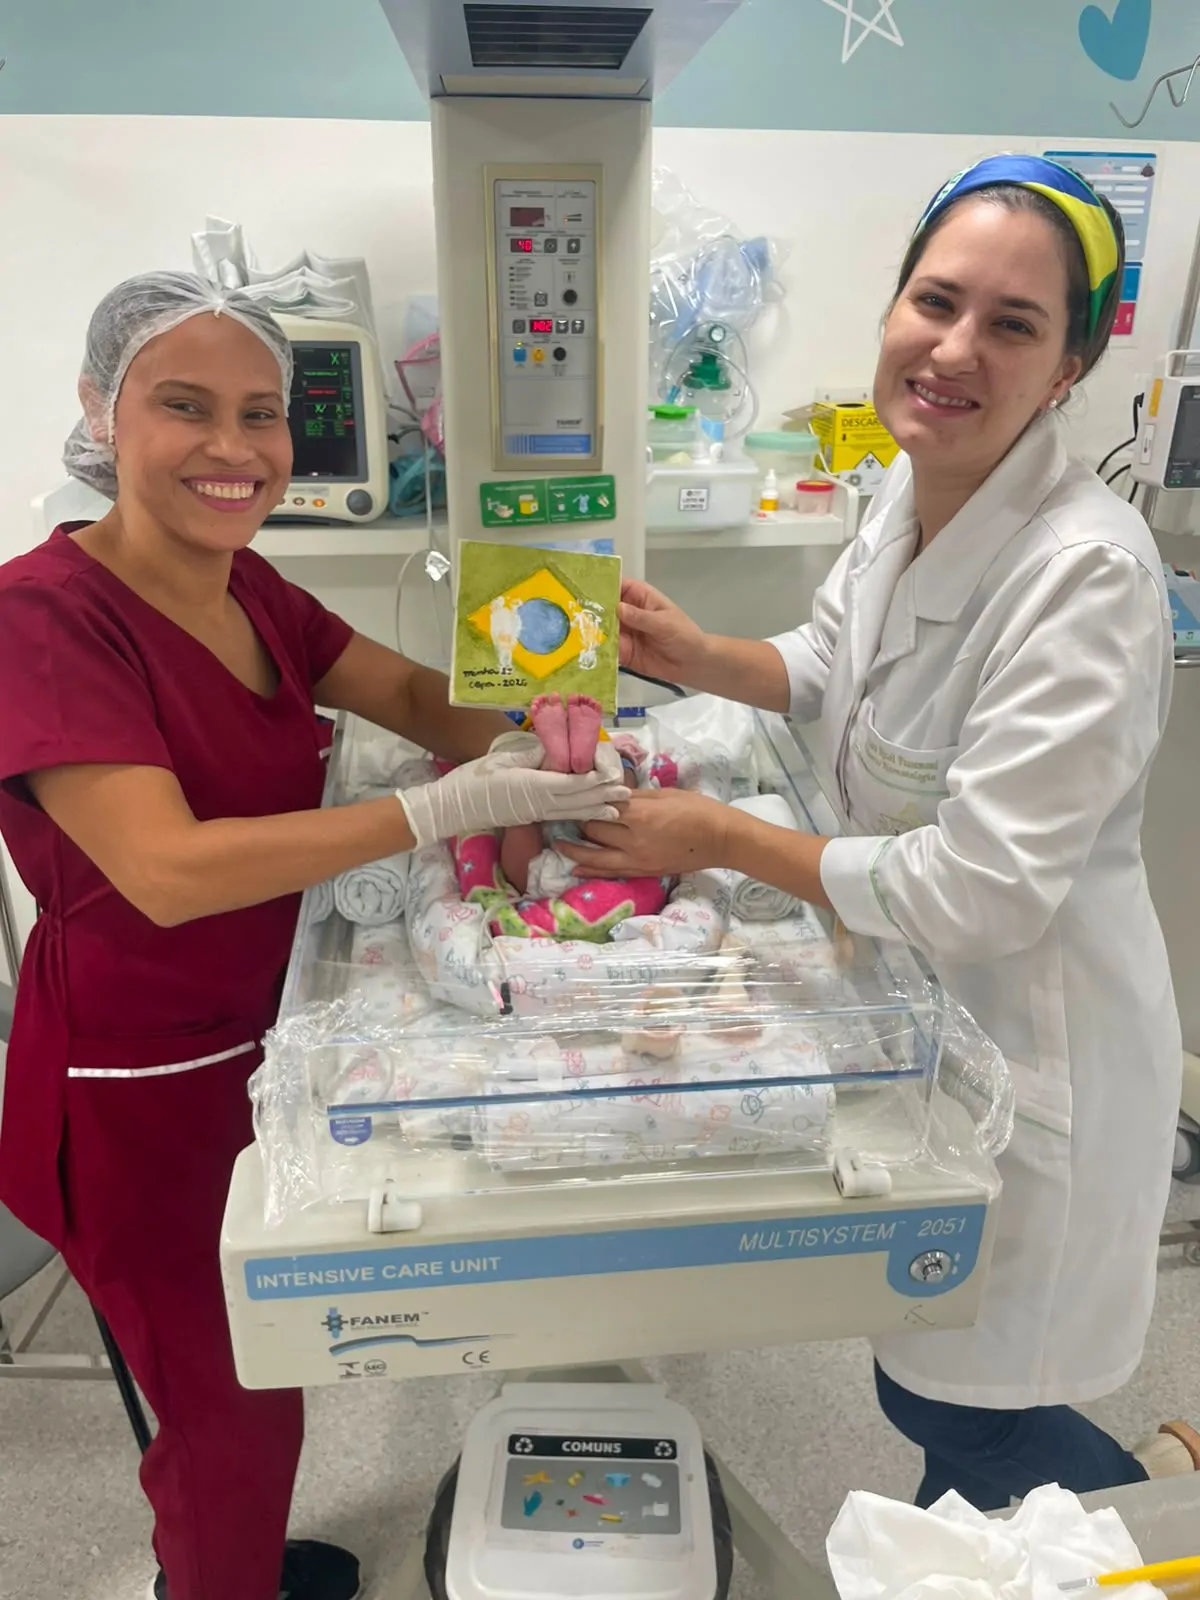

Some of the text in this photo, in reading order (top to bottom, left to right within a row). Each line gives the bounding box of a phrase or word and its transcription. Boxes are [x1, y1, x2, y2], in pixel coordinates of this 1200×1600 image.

[917, 1217, 967, 1238] 2051
[256, 1256, 502, 1289] INTENSIVE CARE UNIT
[561, 1440, 622, 1454] COMUNS
